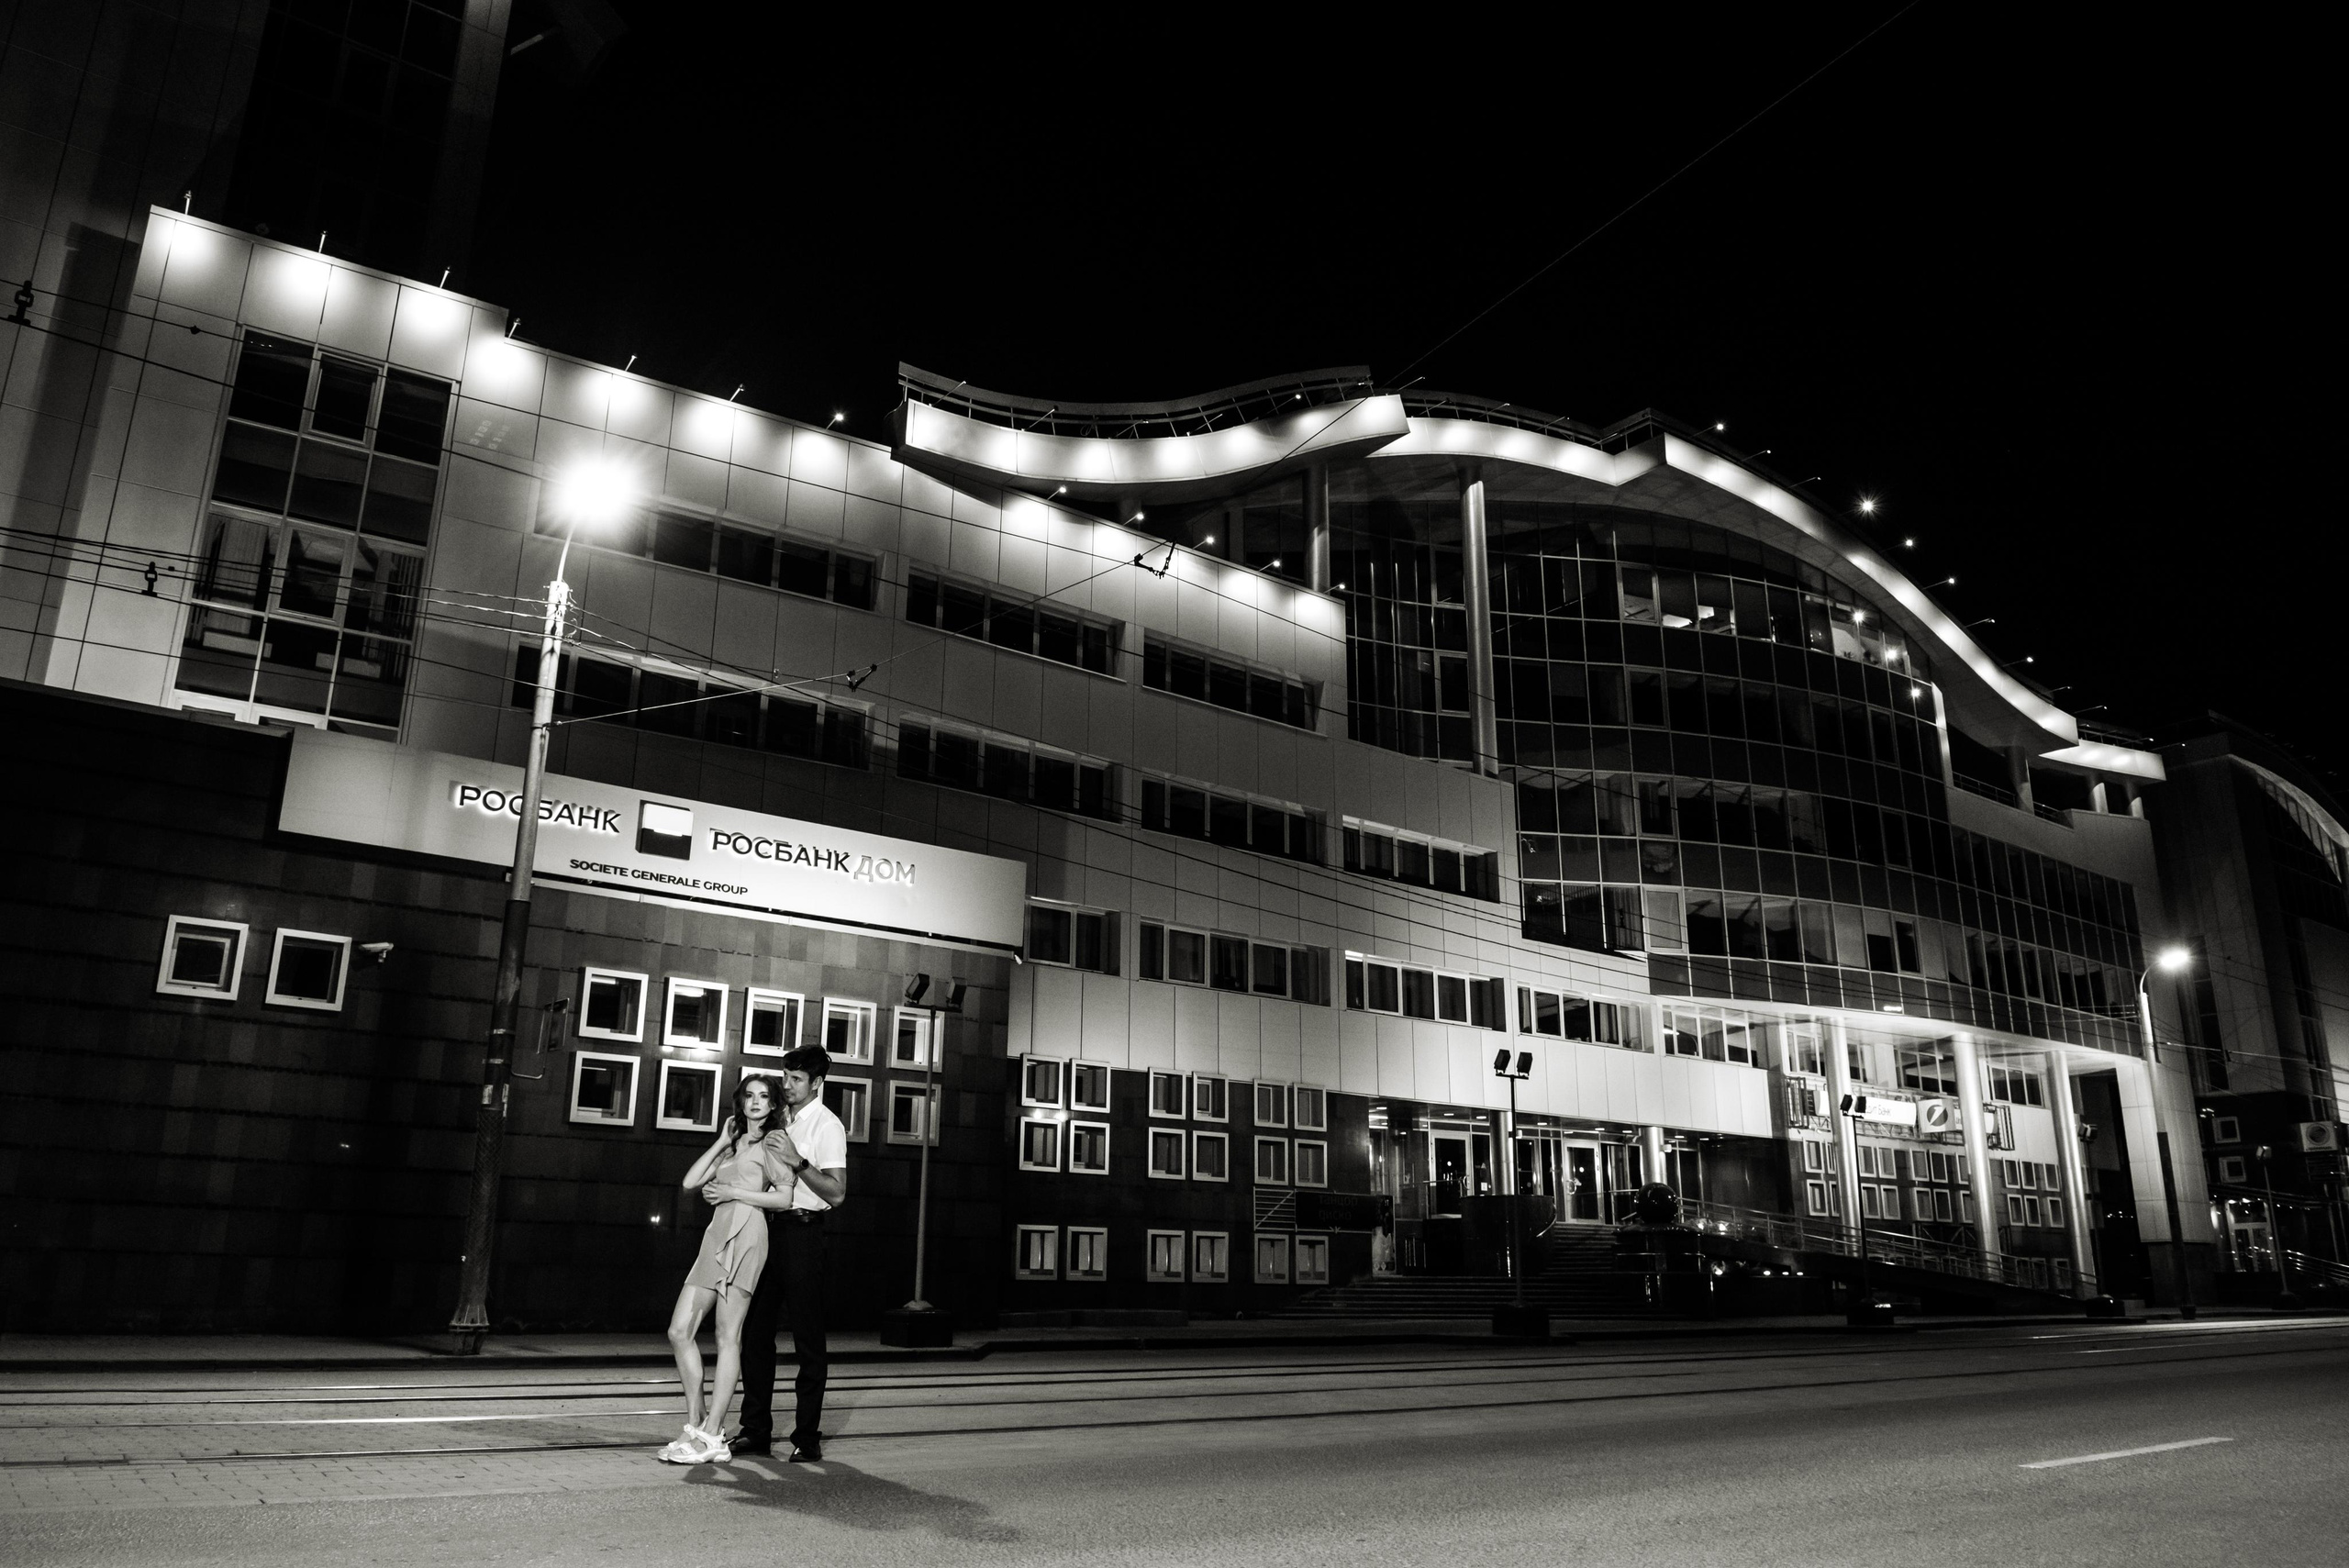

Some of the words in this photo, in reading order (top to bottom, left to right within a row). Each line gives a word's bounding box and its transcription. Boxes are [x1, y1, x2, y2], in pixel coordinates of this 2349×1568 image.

[459, 785, 621, 833] РОСБАНК
[570, 859, 629, 877] SOCIETE
[631, 869, 701, 888] GENERALE
[703, 881, 749, 895] GROUP
[711, 829, 851, 873] РОСБАНК
[853, 854, 916, 884] ДОМ
